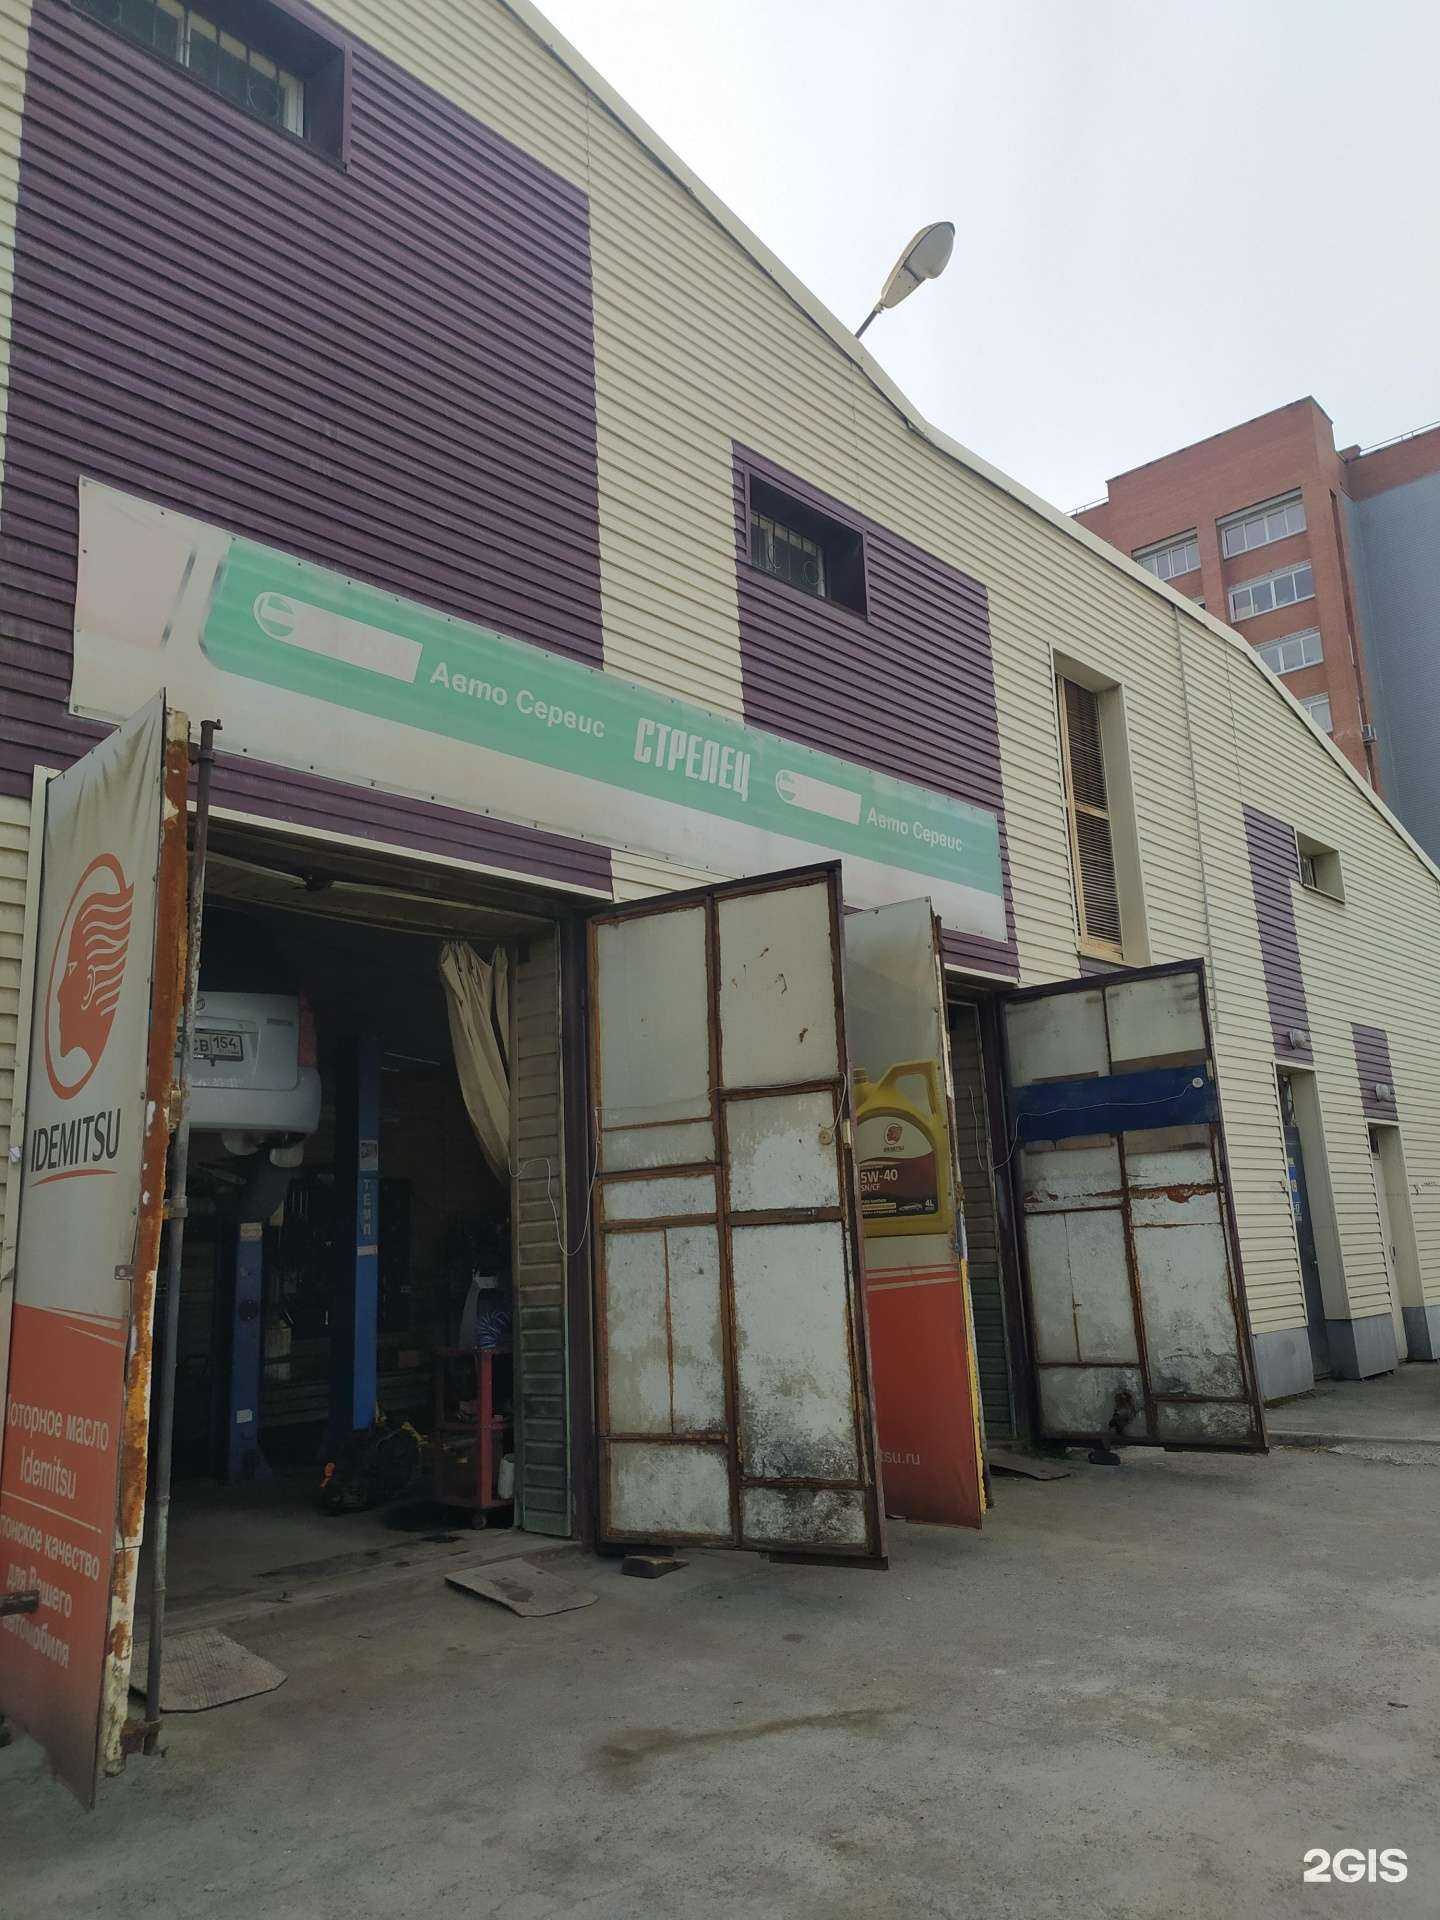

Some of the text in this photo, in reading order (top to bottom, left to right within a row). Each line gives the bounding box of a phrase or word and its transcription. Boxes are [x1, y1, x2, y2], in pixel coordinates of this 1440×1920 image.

[430, 662, 605, 738] Авто Сервис
[633, 717, 750, 802] СТРЕЛЕЦ
[867, 807, 962, 851] Авто Сервис
[31, 1108, 121, 1172] IDEMITSU
[66, 1414, 109, 1452] масло
[20, 1446, 77, 1499] Idemitsu
[44, 1533, 100, 1581] качество
